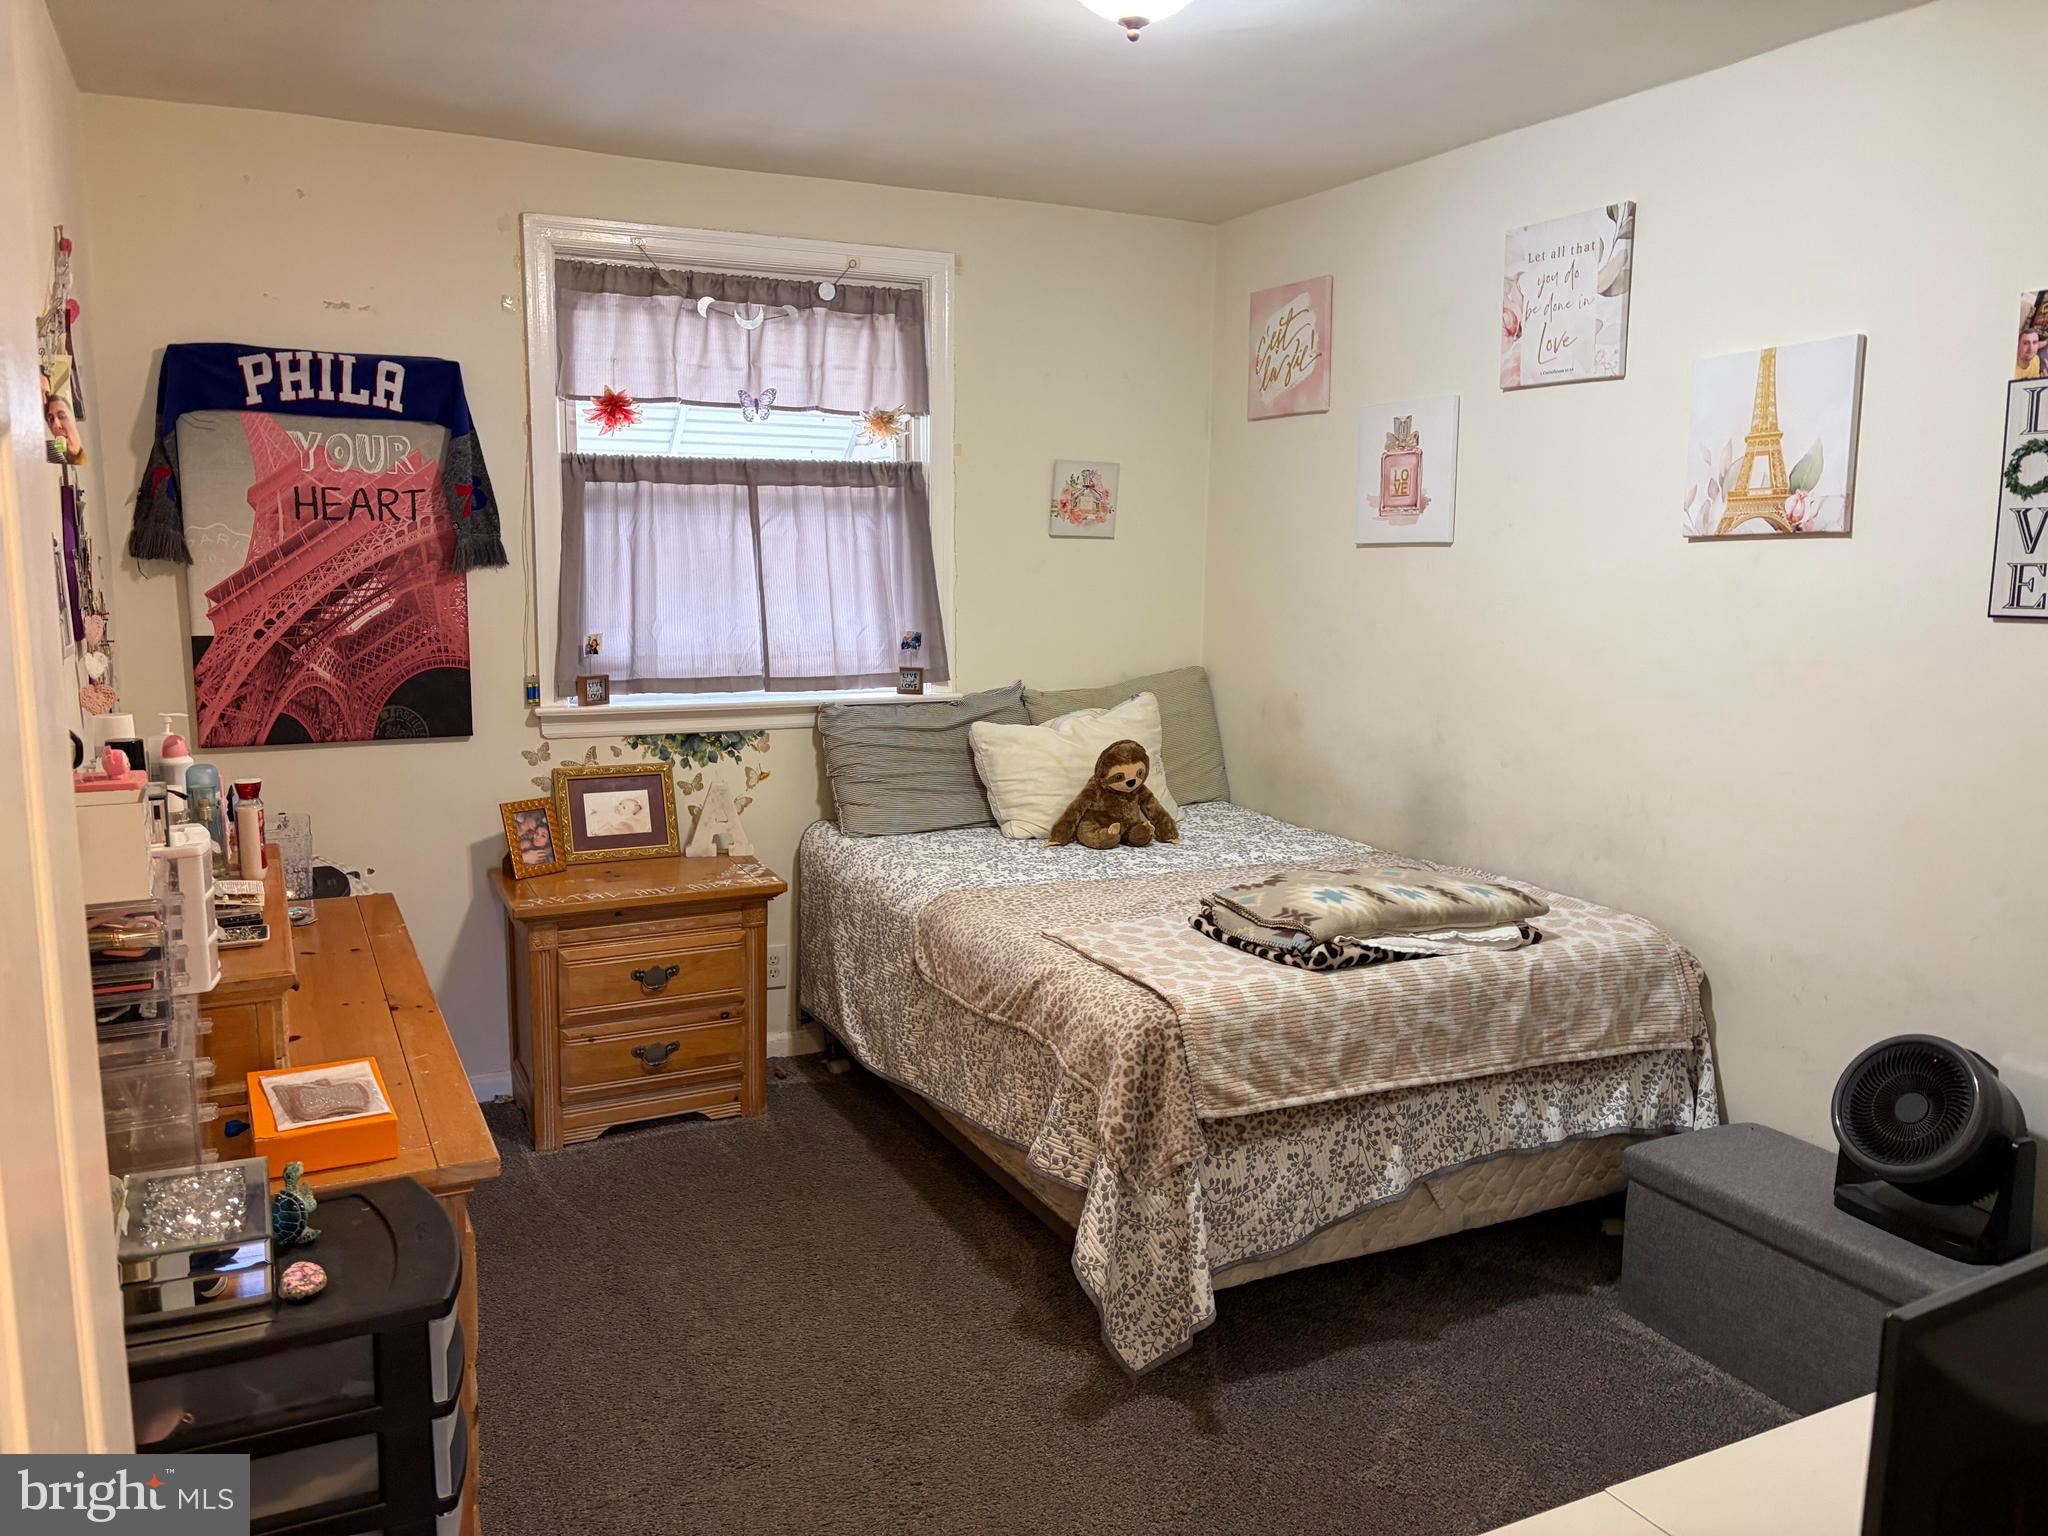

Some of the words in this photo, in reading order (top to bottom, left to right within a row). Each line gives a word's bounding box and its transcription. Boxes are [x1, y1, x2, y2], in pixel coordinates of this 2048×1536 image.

[1528, 251, 1546, 264] Let
[1551, 245, 1566, 259] all
[1570, 240, 1597, 255] that
[1564, 258, 1581, 291] do
[1525, 299, 1541, 323] be
[1543, 292, 1575, 323] done
[1578, 293, 1596, 310] in
[1537, 321, 1579, 365] Love
[237, 351, 406, 414] PHILA
[286, 430, 416, 475] YOUR
[293, 485, 426, 522] HEART
